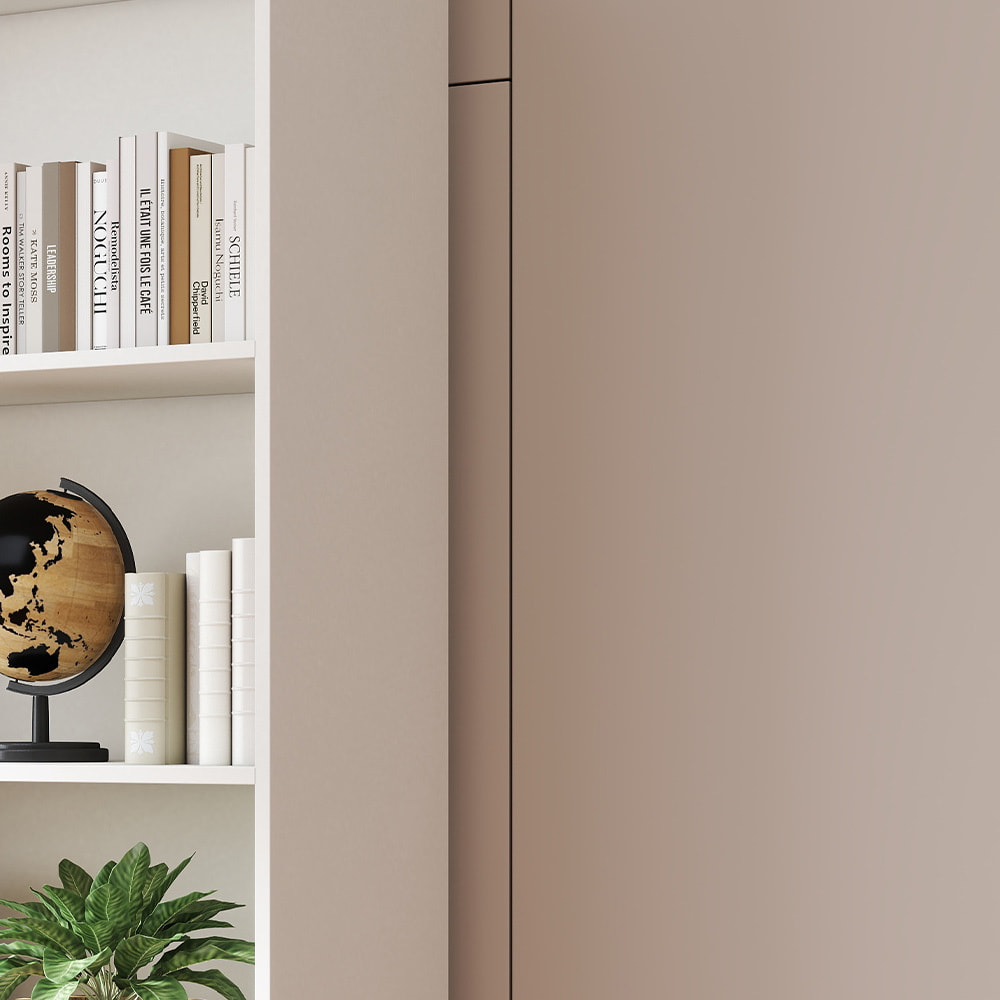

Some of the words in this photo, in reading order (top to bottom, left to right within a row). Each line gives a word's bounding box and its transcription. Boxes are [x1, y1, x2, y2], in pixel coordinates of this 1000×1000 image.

[139, 188, 151, 198] IL
[139, 199, 153, 226] ÉTAIT
[139, 230, 151, 249] UNE
[214, 219, 224, 250] Isamu
[2, 226, 12, 278] Rooms
[30, 239, 38, 270] KATE
[93, 210, 107, 314] NOGUCHI
[110, 221, 120, 291] Remodelista
[139, 251, 151, 273] FOIS
[228, 236, 241, 298] SCHIELE
[46, 244, 57, 293] LEADERSHIP
[139, 275, 151, 287] LE
[213, 254, 225, 302] Noguchi
[2, 282, 12, 298] to
[30, 272, 38, 304] MOSS
[139, 290, 153, 315] CAFÉ
[200, 280, 209, 305] David
[191, 281, 200, 335] Chipperfield
[0, 303, 13, 356] Inspire
